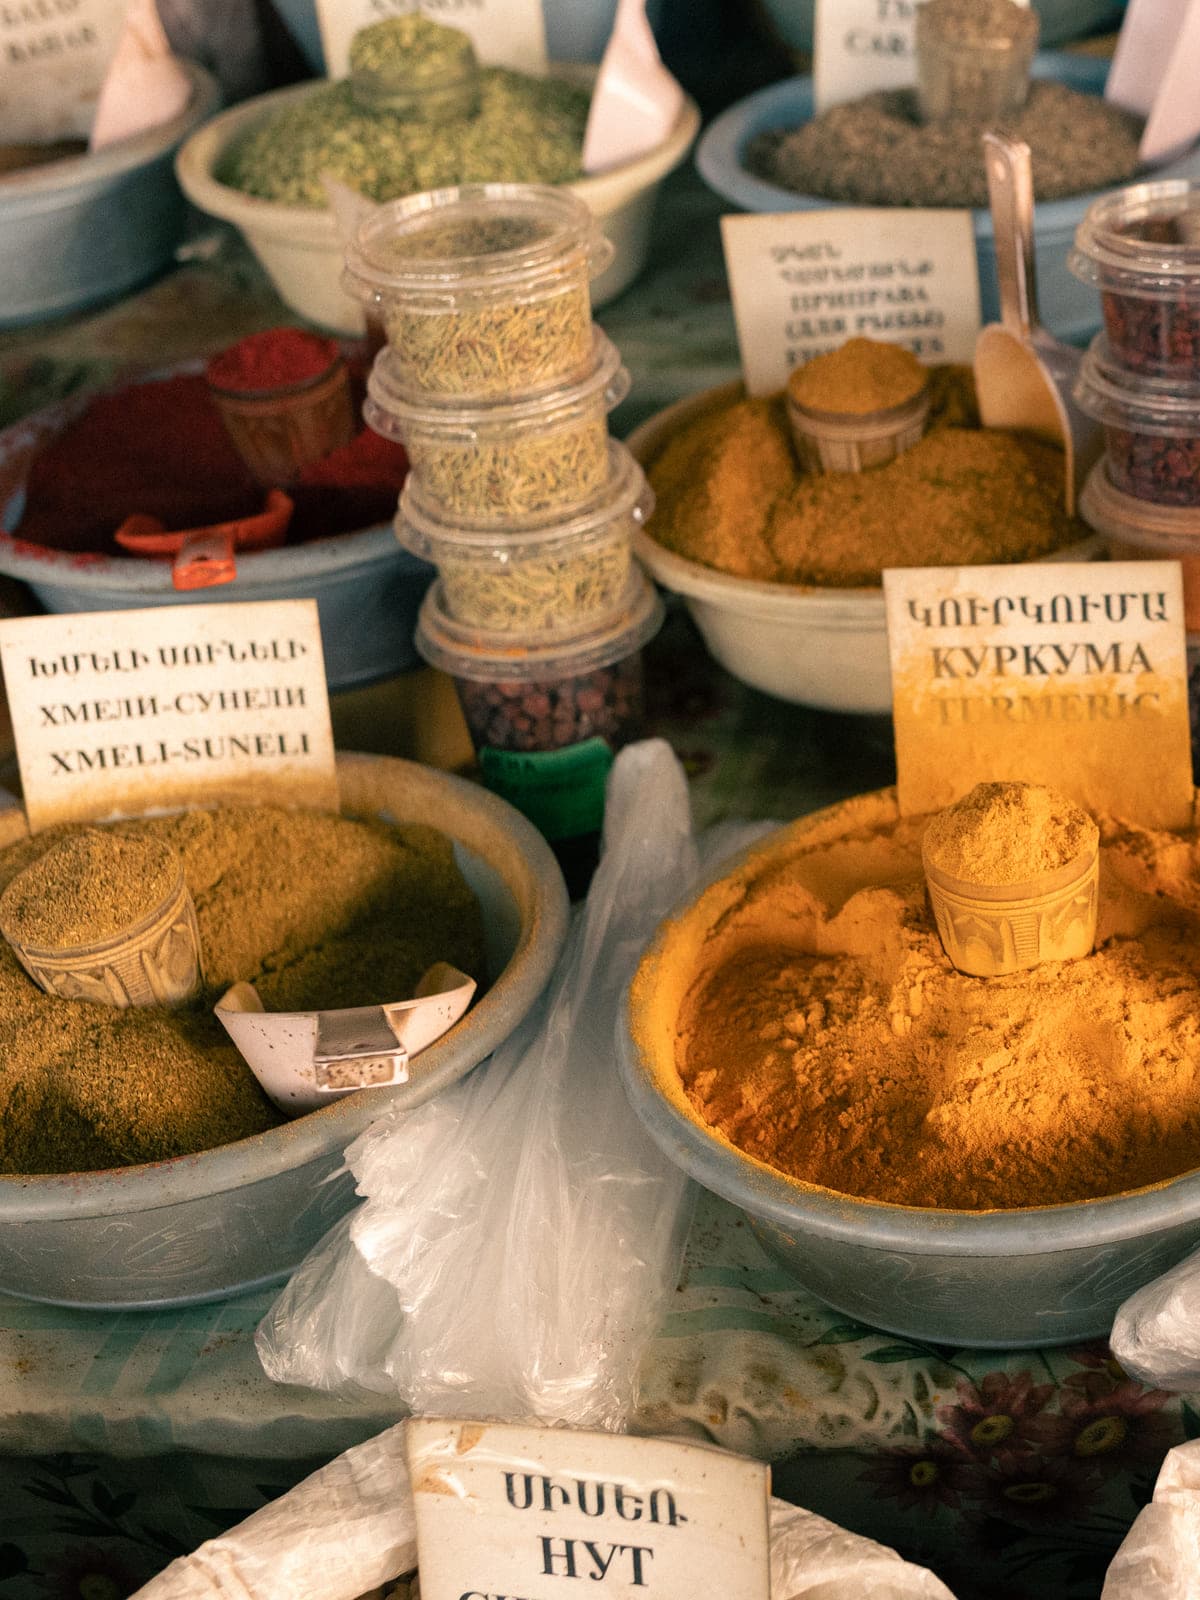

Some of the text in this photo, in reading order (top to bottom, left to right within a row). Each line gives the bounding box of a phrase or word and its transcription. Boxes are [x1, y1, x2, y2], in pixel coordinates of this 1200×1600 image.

[906, 591, 1169, 628] ԿՈՒՐԿՈՒՄԱ
[27, 637, 308, 679] ԽՄԵԼԻ ՍՈՒՆԵԼԻ
[930, 642, 1155, 678] КУРКУМА
[39, 686, 307, 728] ХМЕЛИ-СУНЕЛИ
[50, 732, 311, 776] XMELI-SUNELI
[500, 1470, 689, 1528] ՍԻՍԵՌ
[537, 1534, 655, 1587] НУТ
